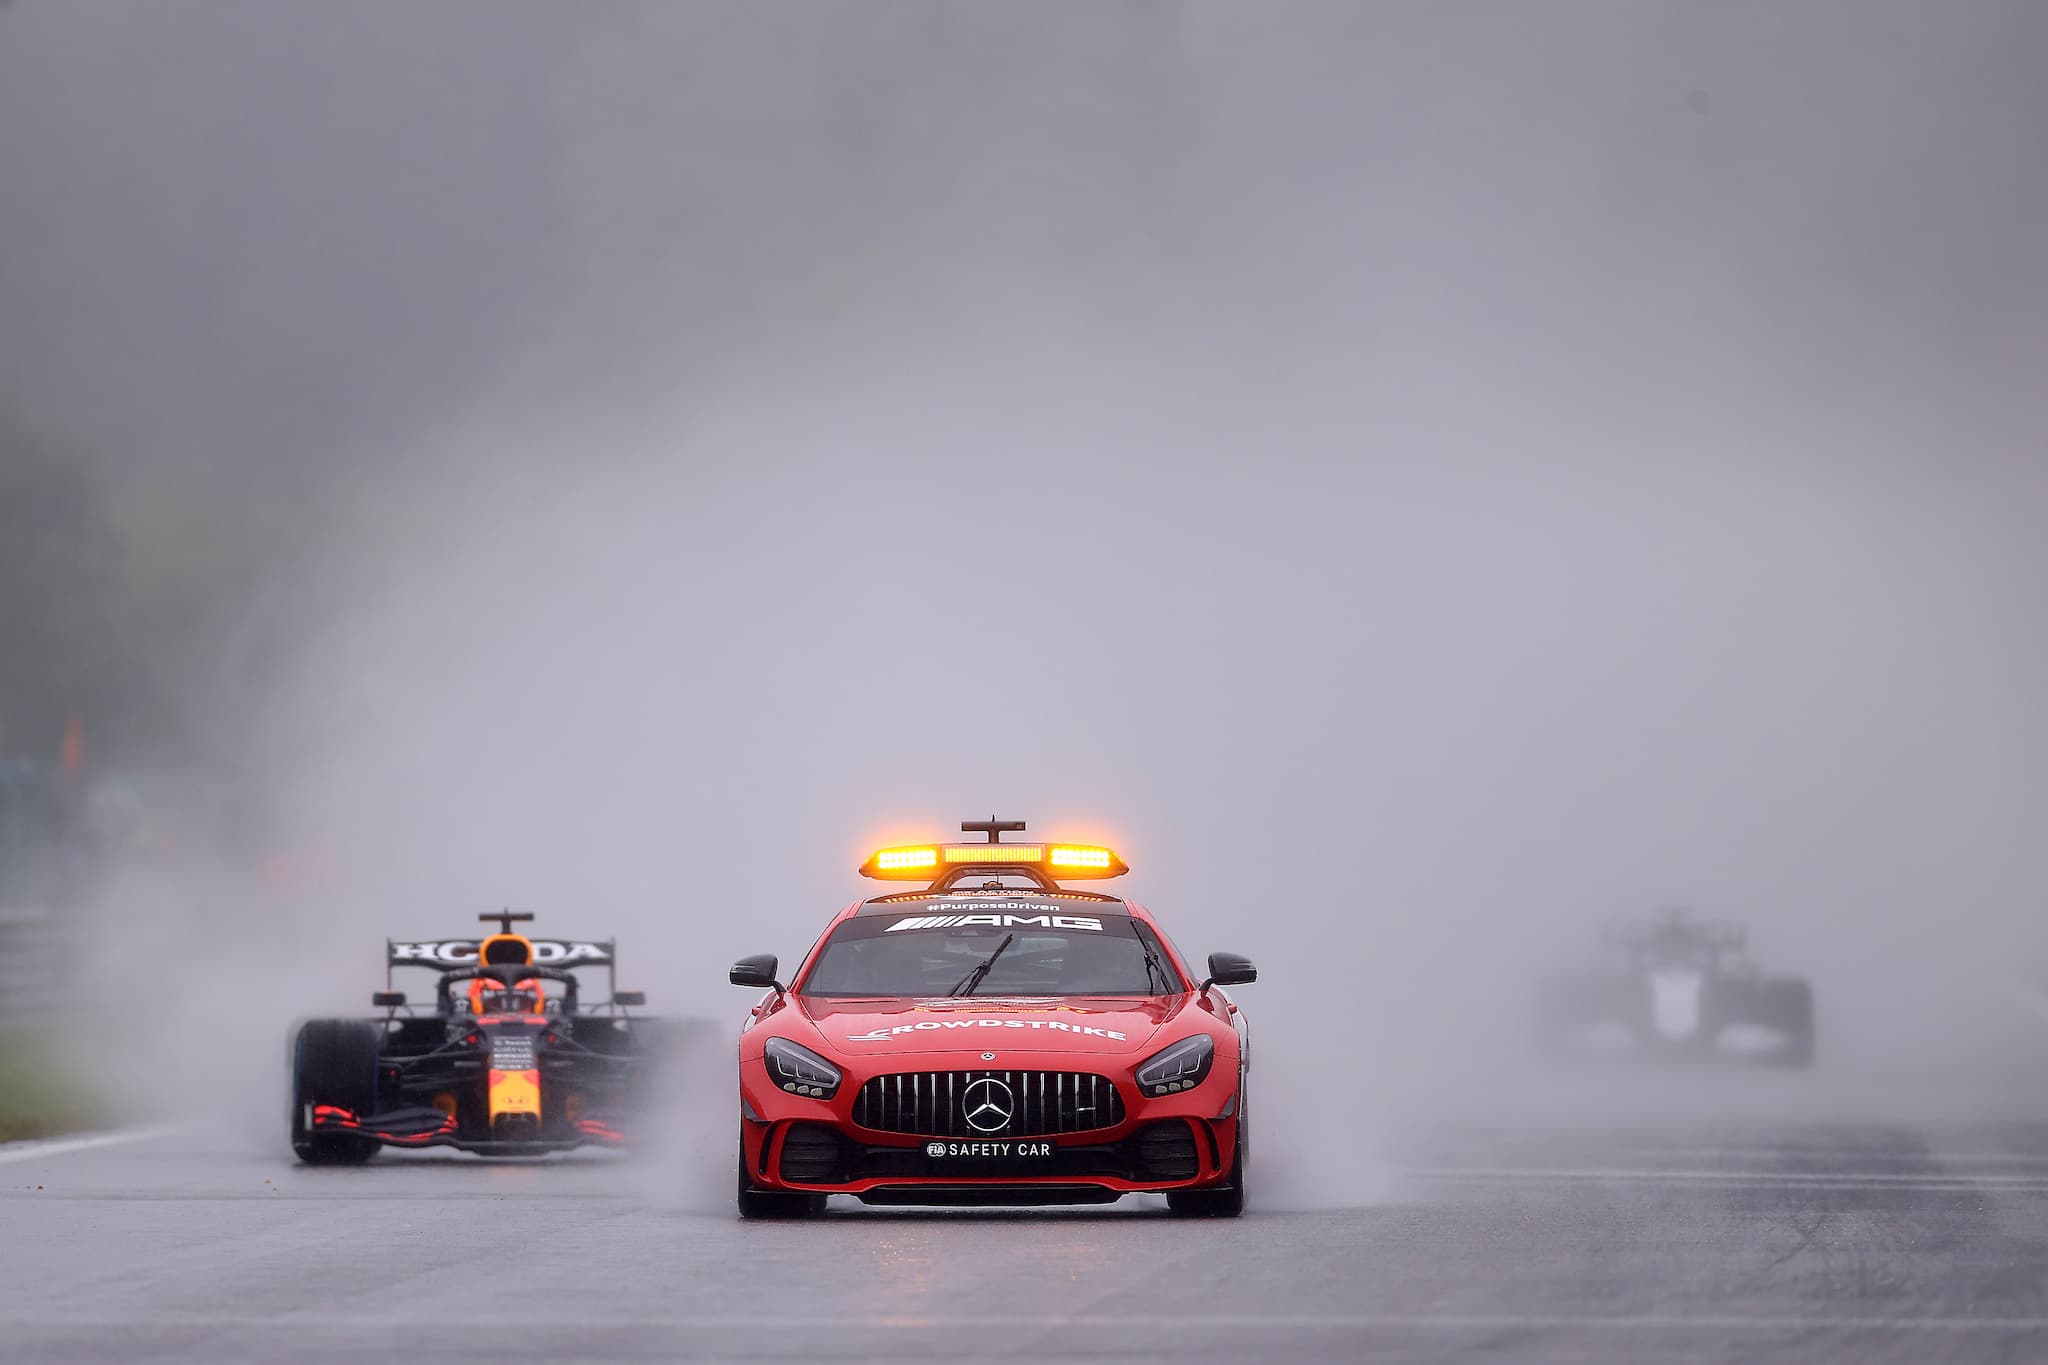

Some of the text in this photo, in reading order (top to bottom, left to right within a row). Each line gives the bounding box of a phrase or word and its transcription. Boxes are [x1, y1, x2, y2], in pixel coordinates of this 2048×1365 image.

[926, 902, 1061, 912] #PurposeDriven
[954, 914, 1103, 931] AMG
[393, 942, 611, 962] HODA
[863, 1019, 1128, 1041] CROWDSTRIKE
[949, 1143, 1010, 1156] SAFETY
[1017, 1143, 1050, 1156] CAR
